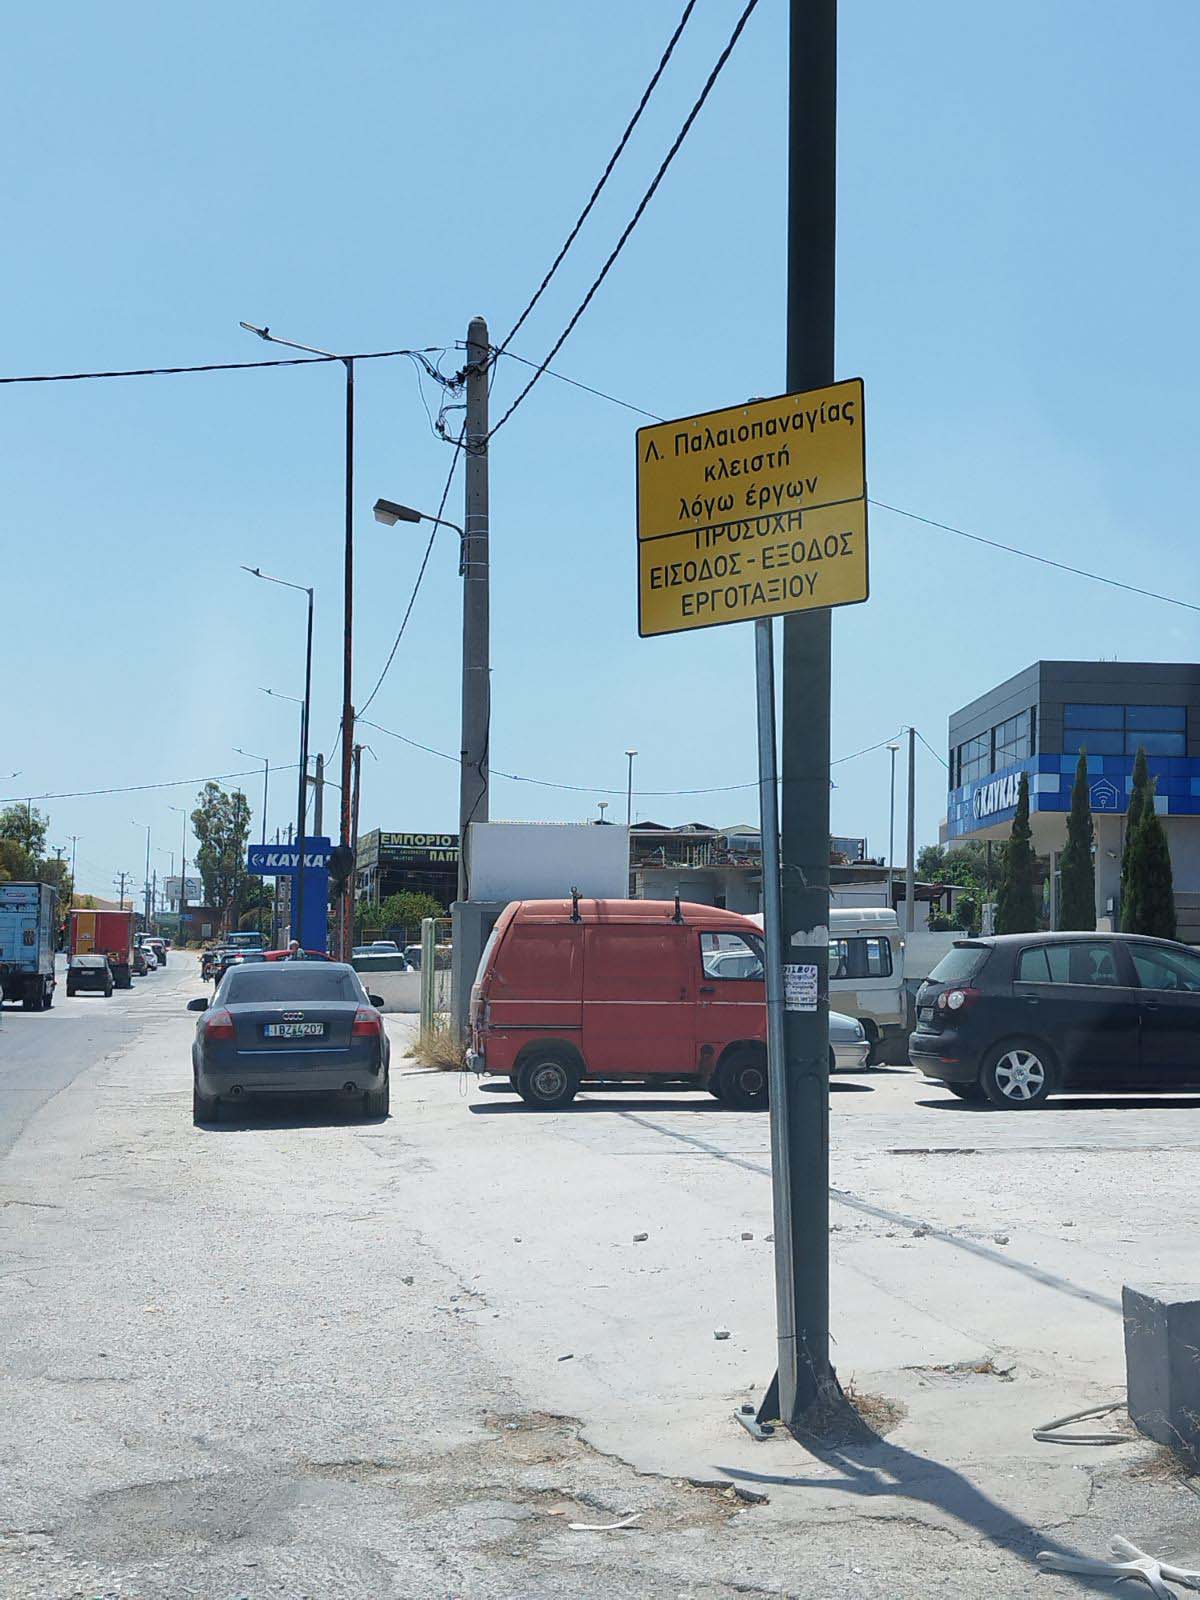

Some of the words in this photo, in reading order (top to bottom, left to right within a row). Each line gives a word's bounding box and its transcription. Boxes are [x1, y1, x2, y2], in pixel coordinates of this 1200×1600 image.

[644, 439, 664, 463] Λ.
[674, 401, 855, 457] Παλαιοπαναγίας
[703, 443, 791, 483] κλειστή
[678, 494, 734, 521] λόγω
[745, 476, 818, 510] έργων
[694, 511, 803, 550] ΠΡΟΣΟΧΗ
[650, 552, 741, 590] ΕΙΣΟΔΟΣ
[761, 531, 854, 570] ΕΞΟΔΟΣ
[681, 571, 819, 617] ΕΡΓΟΤΑΞΙΟΥ
[265, 853, 331, 868] ΚΑΥΚΑ
[380, 833, 452, 847] ΕΜΠΟΡΙΟ
